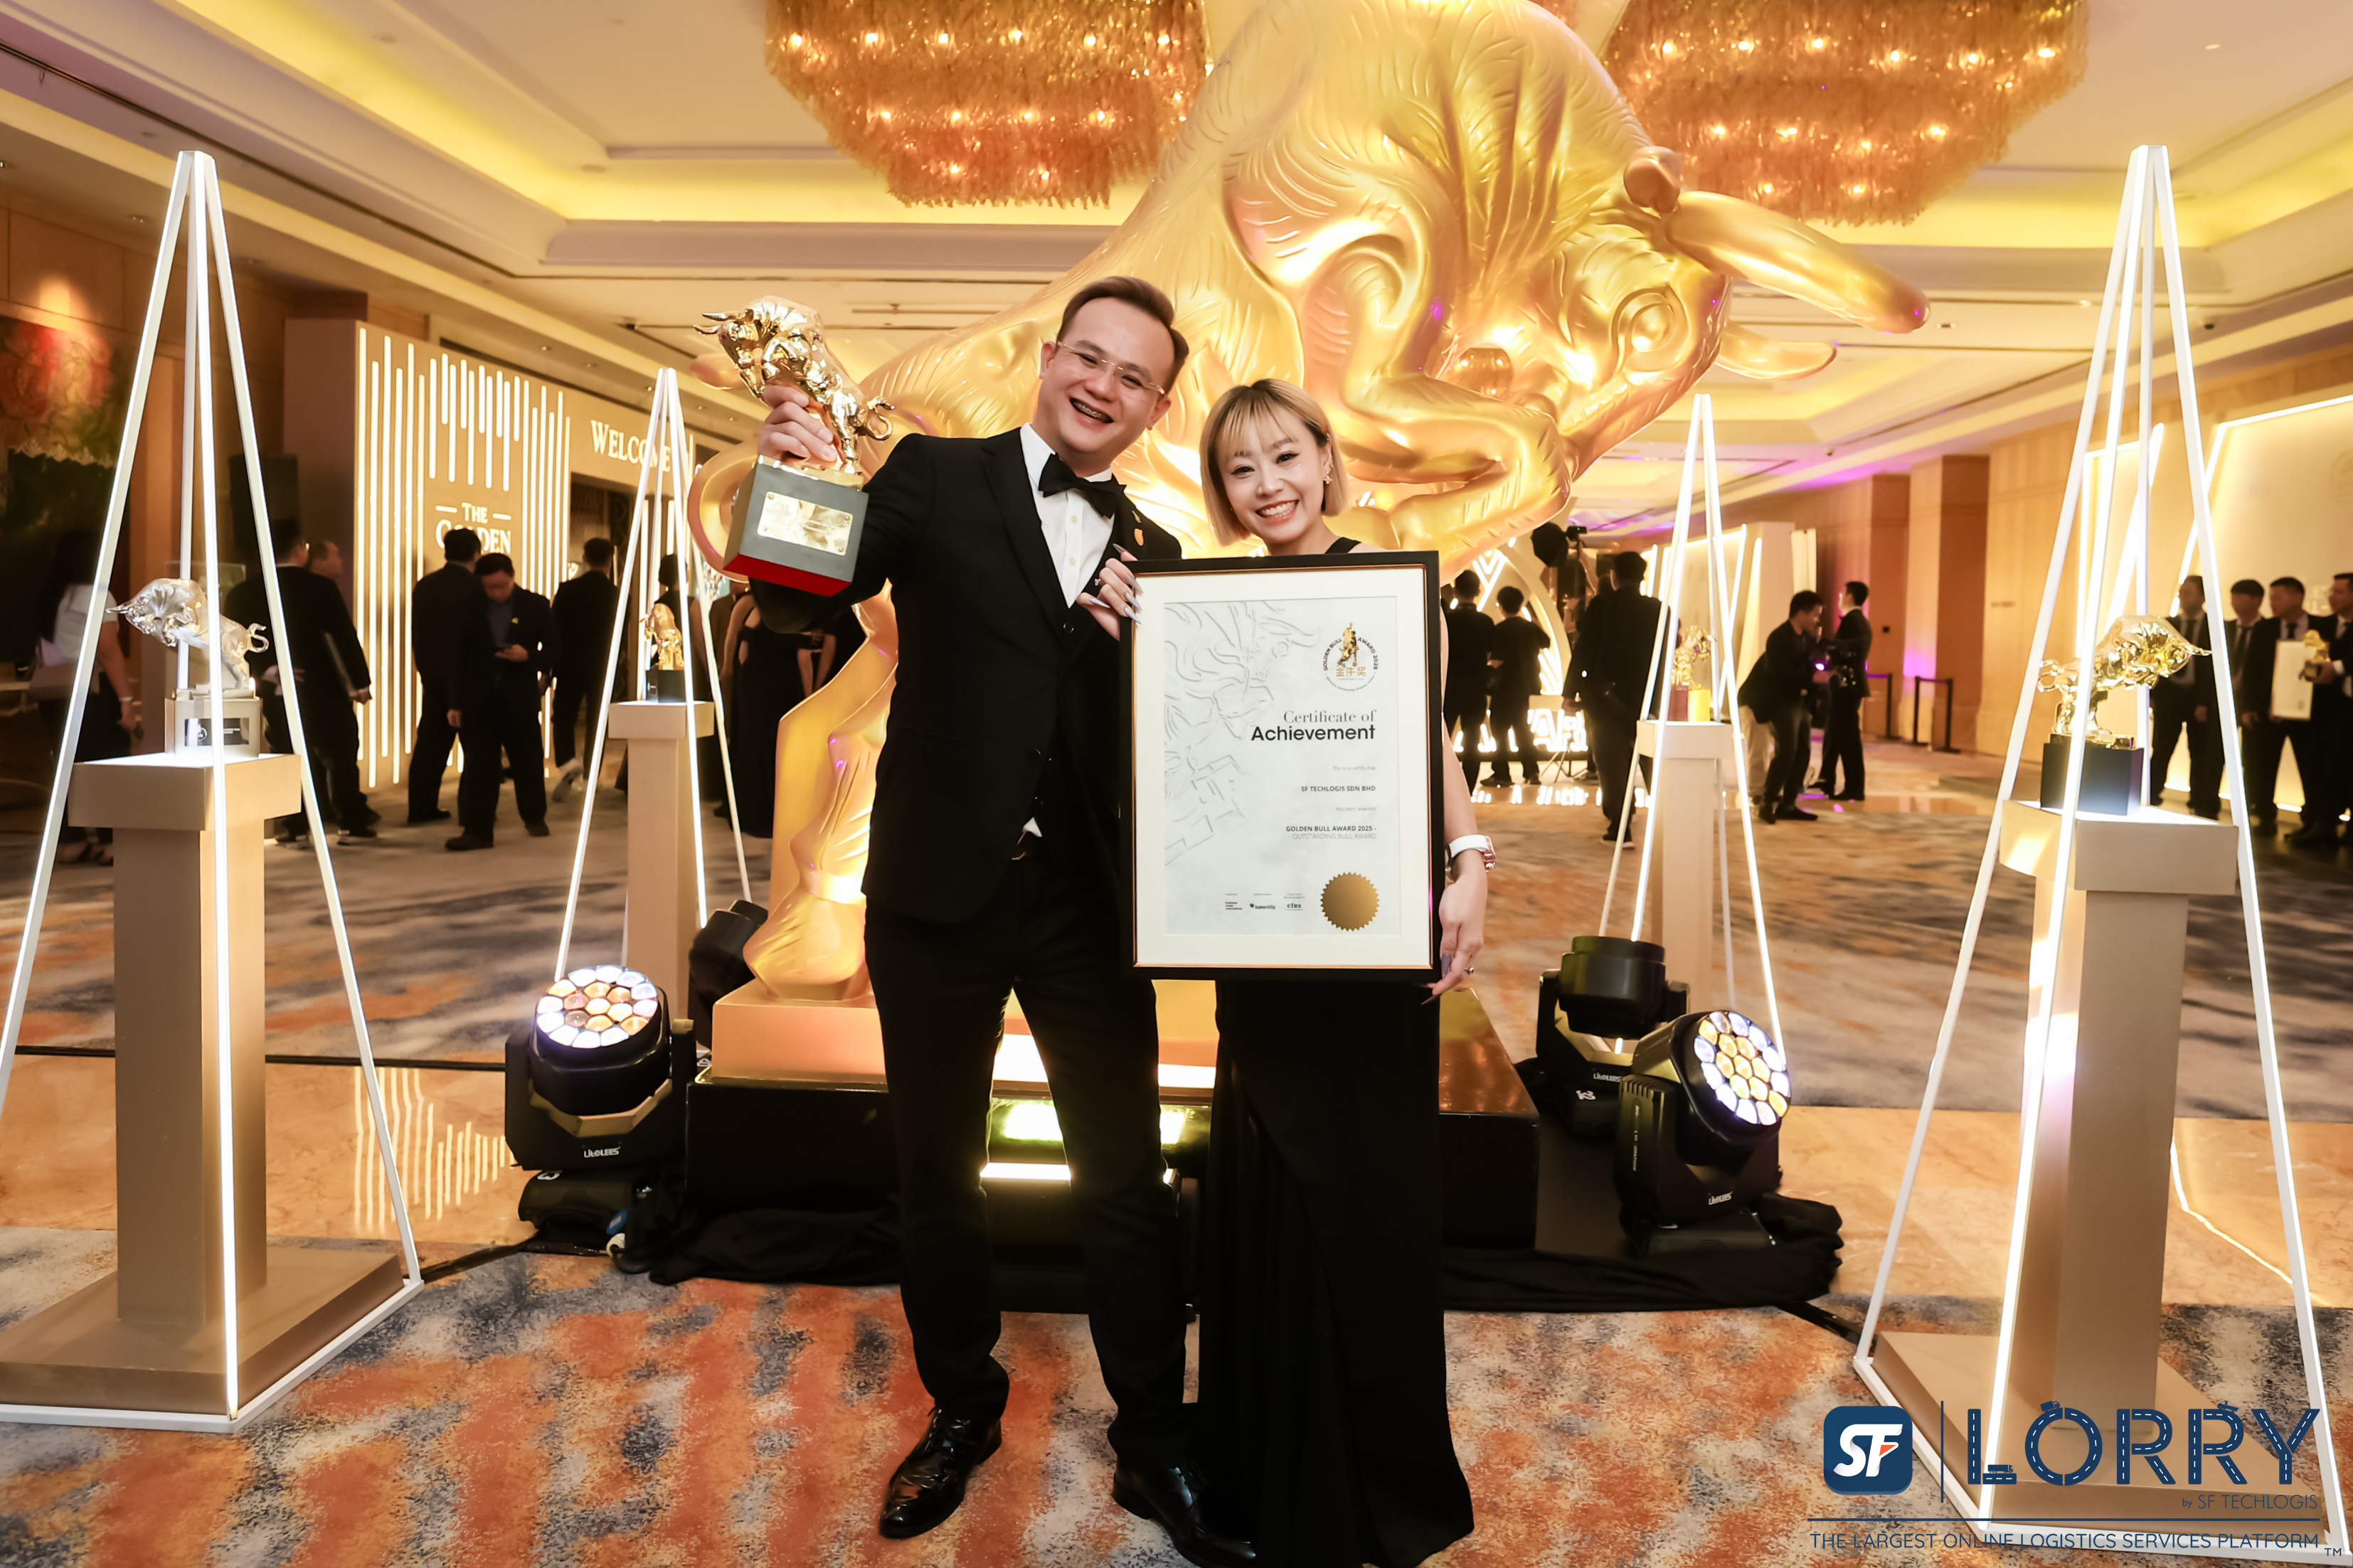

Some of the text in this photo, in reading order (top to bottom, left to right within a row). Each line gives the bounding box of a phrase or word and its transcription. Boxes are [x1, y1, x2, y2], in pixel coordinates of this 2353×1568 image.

[462, 502, 488, 524] THE
[435, 519, 511, 555] GDEN
[1329, 639, 1342, 649] BULL
[1358, 637, 1376, 654] AWARD
[1336, 666, 1366, 676] 金牛奖
[1284, 709, 1376, 723] Certificate of
[1251, 725, 1375, 741] Achievement
